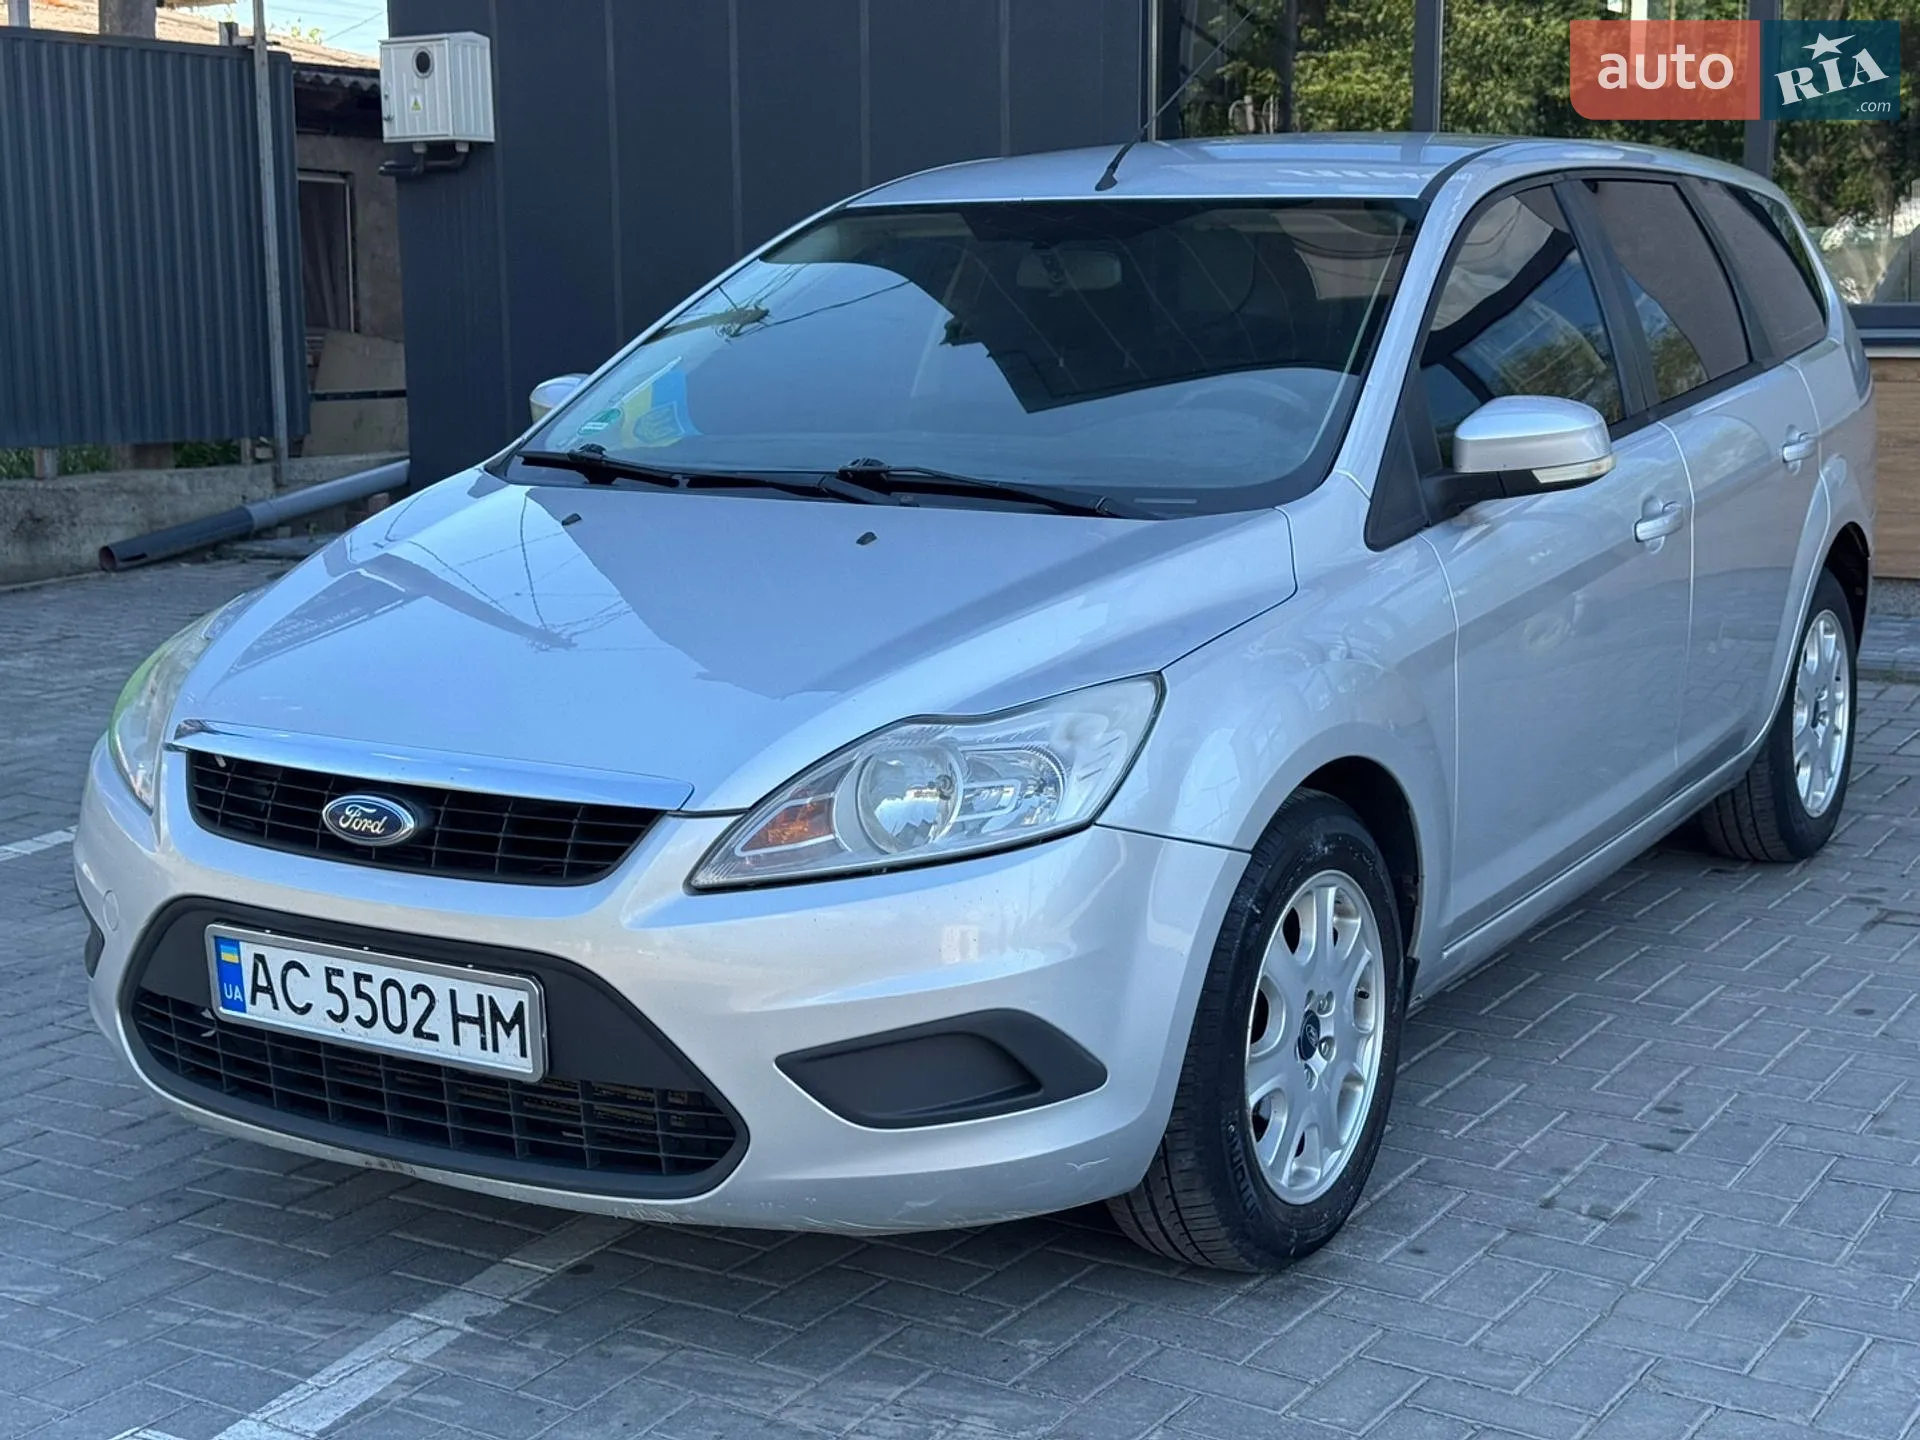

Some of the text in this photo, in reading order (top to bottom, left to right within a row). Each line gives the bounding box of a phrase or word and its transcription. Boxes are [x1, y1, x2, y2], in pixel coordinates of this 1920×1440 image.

[339, 803, 388, 834] Ford
[224, 983, 244, 1002] UA
[250, 953, 528, 1059] AC 5502 HM
